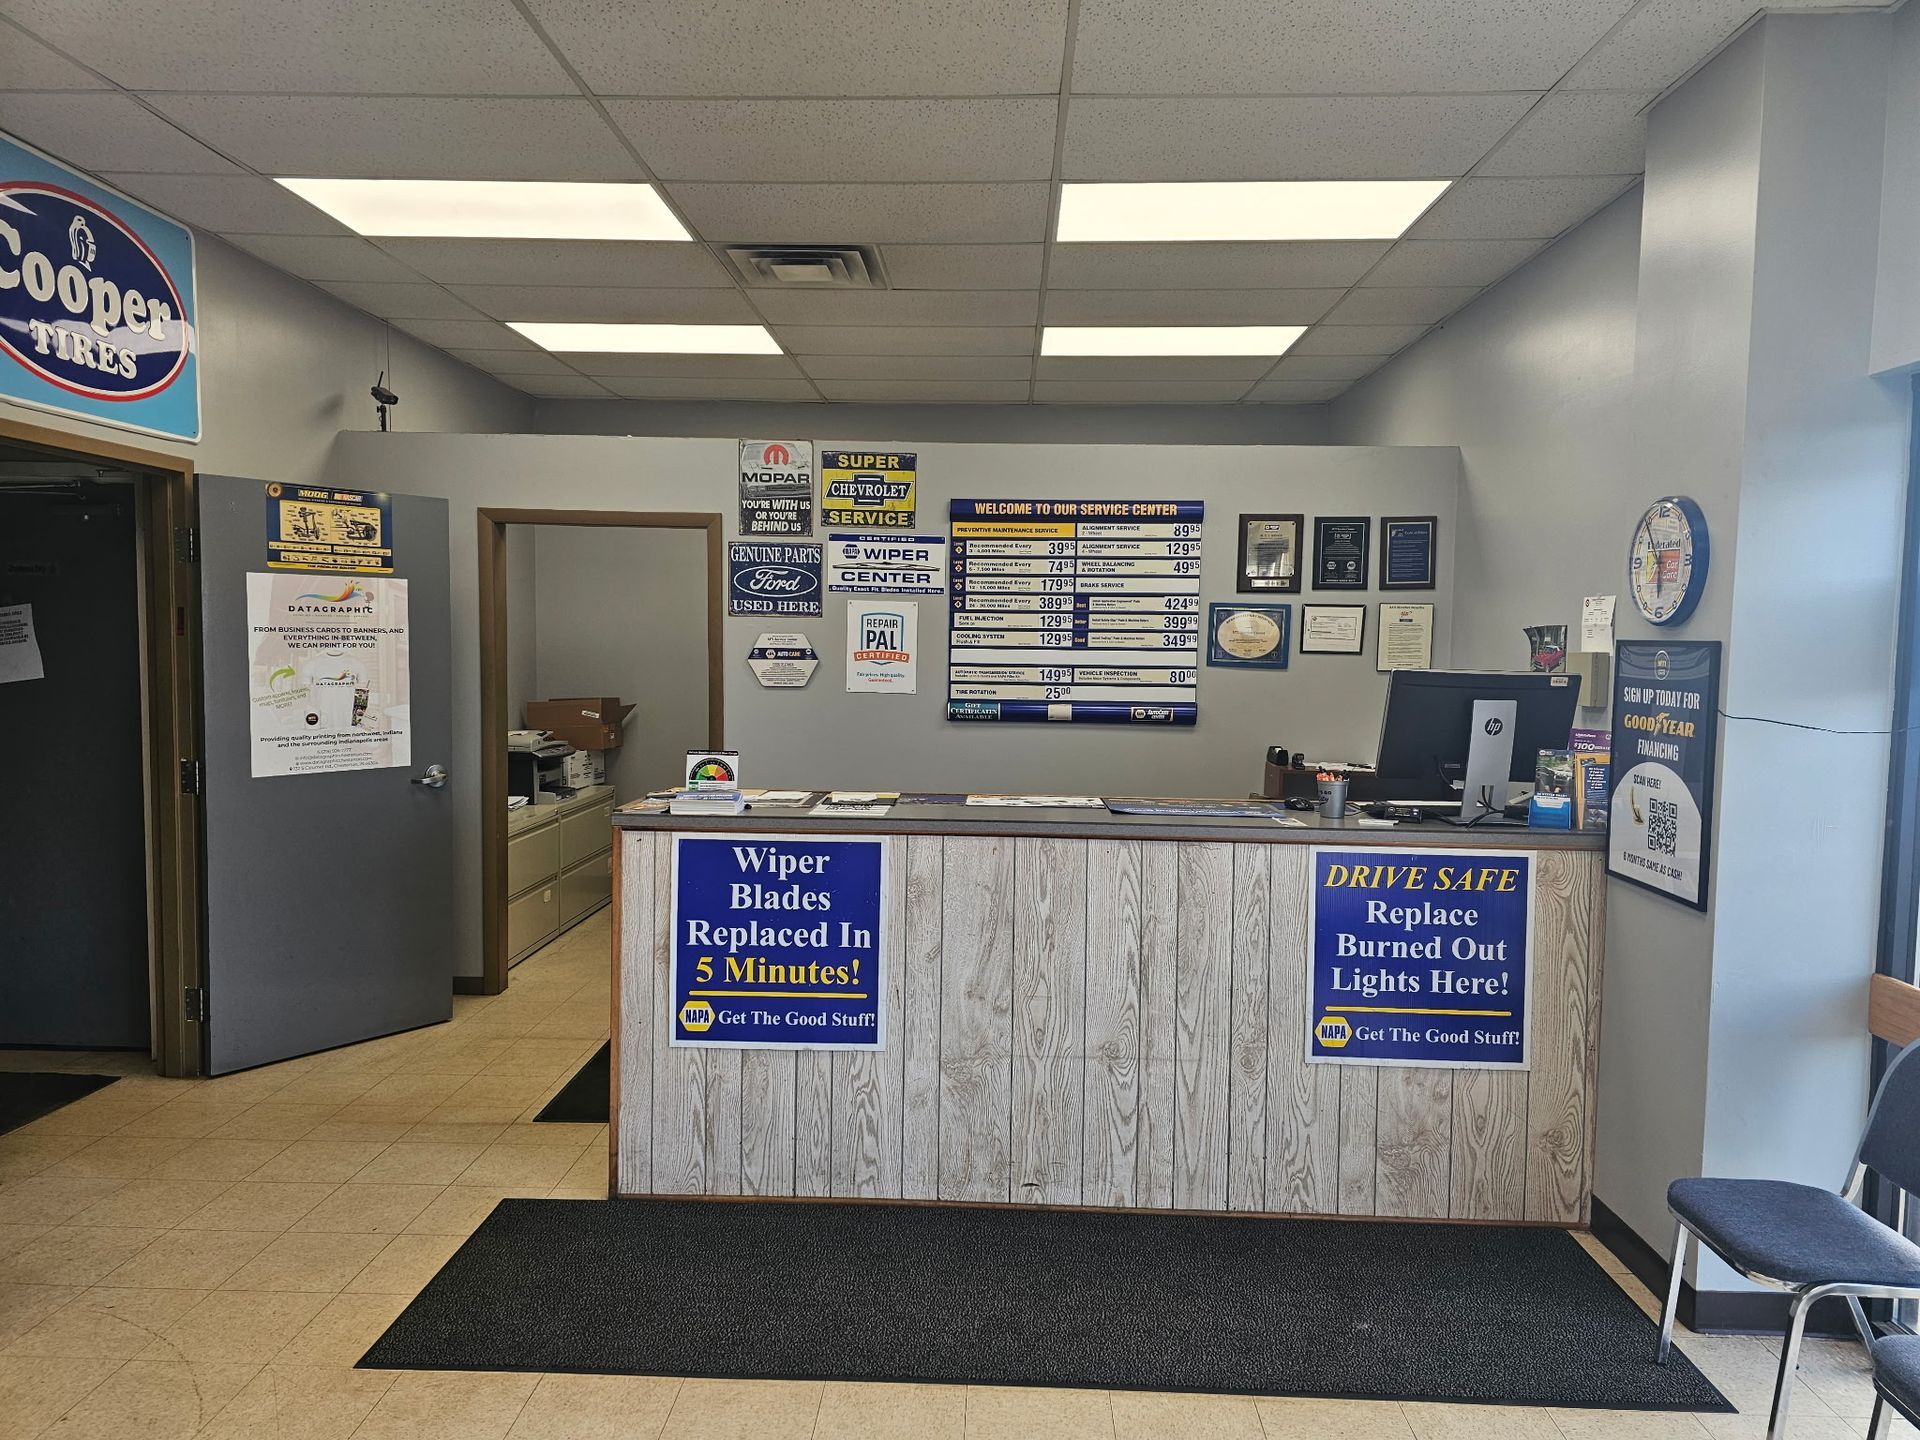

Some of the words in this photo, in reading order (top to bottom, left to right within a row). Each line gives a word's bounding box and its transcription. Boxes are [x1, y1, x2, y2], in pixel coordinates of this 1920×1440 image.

[28, 318, 137, 380] TIRES
[837, 455, 900, 469] SUPER
[741, 472, 810, 484] MOPAR
[831, 483, 907, 498] CHEVROLET
[742, 500, 771, 509] YOU'RE
[772, 499, 799, 510] WITH
[800, 500, 811, 510] US
[974, 502, 1032, 515] WELCOME
[1035, 503, 1050, 515] TO
[1053, 503, 1077, 515] OUR
[1080, 503, 1129, 516] SERVICE
[1132, 503, 1178, 516] CENTER
[1659, 505, 1671, 518] 12
[755, 511, 767, 520] OR
[768, 511, 797, 520] YOU'RE
[828, 512, 908, 526] SERVICE
[751, 521, 789, 532] BEHIND
[790, 522, 801, 531] US
[1647, 538, 1681, 550] Fderated
[730, 547, 783, 563] GENUINE
[784, 547, 821, 564] PARTS
[863, 548, 929, 561] WIPER
[1633, 557, 1643, 570] 9
[1666, 560, 1679, 569] Car
[749, 569, 802, 591] Ford
[841, 571, 931, 584] CENTER
[288, 605, 374, 614] DATAGRAPHIC
[732, 600, 774, 612] USED
[1654, 606, 1664, 619] 6
[866, 618, 899, 629] REPAIR
[866, 629, 898, 651] PAL
[856, 652, 908, 661] CERTIFIED
[1623, 686, 1641, 703] SIGN
[1643, 688, 1655, 704] UP
[1655, 689, 1682, 708] TODAY
[1683, 692, 1700, 710] FOR
[1486, 718, 1502, 736] hp
[1624, 713, 1695, 738] GOODYEAR
[260, 735, 290, 743] Providing
[290, 734, 311, 742] quality
[312, 733, 337, 741] printing
[1573, 742, 1595, 751] $100
[1637, 739, 1679, 761] FINANCING
[1633, 774, 1646, 787] SCAN
[1646, 778, 1661, 790] HERE!
[732, 846, 831, 881] Wiper
[1626, 852, 1646, 868] MONTHS
[1646, 859, 1659, 873] SAME
[1660, 864, 1667, 875] AS
[1667, 866, 1683, 881] CASH!
[1323, 864, 1428, 891] DRIVE
[1433, 867, 1520, 892] SAFE
[729, 883, 831, 911] Blades
[1365, 900, 1479, 932] Replace
[686, 919, 829, 954] Replaced
[838, 922, 872, 949] In
[1336, 933, 1442, 959] Burned
[1451, 936, 1508, 961] Out
[695, 956, 714, 983] 5
[723, 956, 860, 985] Minutes!
[1330, 966, 1420, 998] Lights
[1429, 969, 1509, 996] Here!
[685, 1009, 710, 1024] NAPA
[718, 1010, 747, 1025] Get
[751, 1010, 781, 1026] The
[785, 1011, 827, 1027] Good
[831, 1012, 876, 1027] Stuff!
[1321, 1025, 1347, 1040] NAPA
[1355, 1026, 1385, 1041] Get
[1389, 1027, 1421, 1043] The
[1425, 1028, 1469, 1044] Good
[1474, 1029, 1520, 1045] Stuff!
